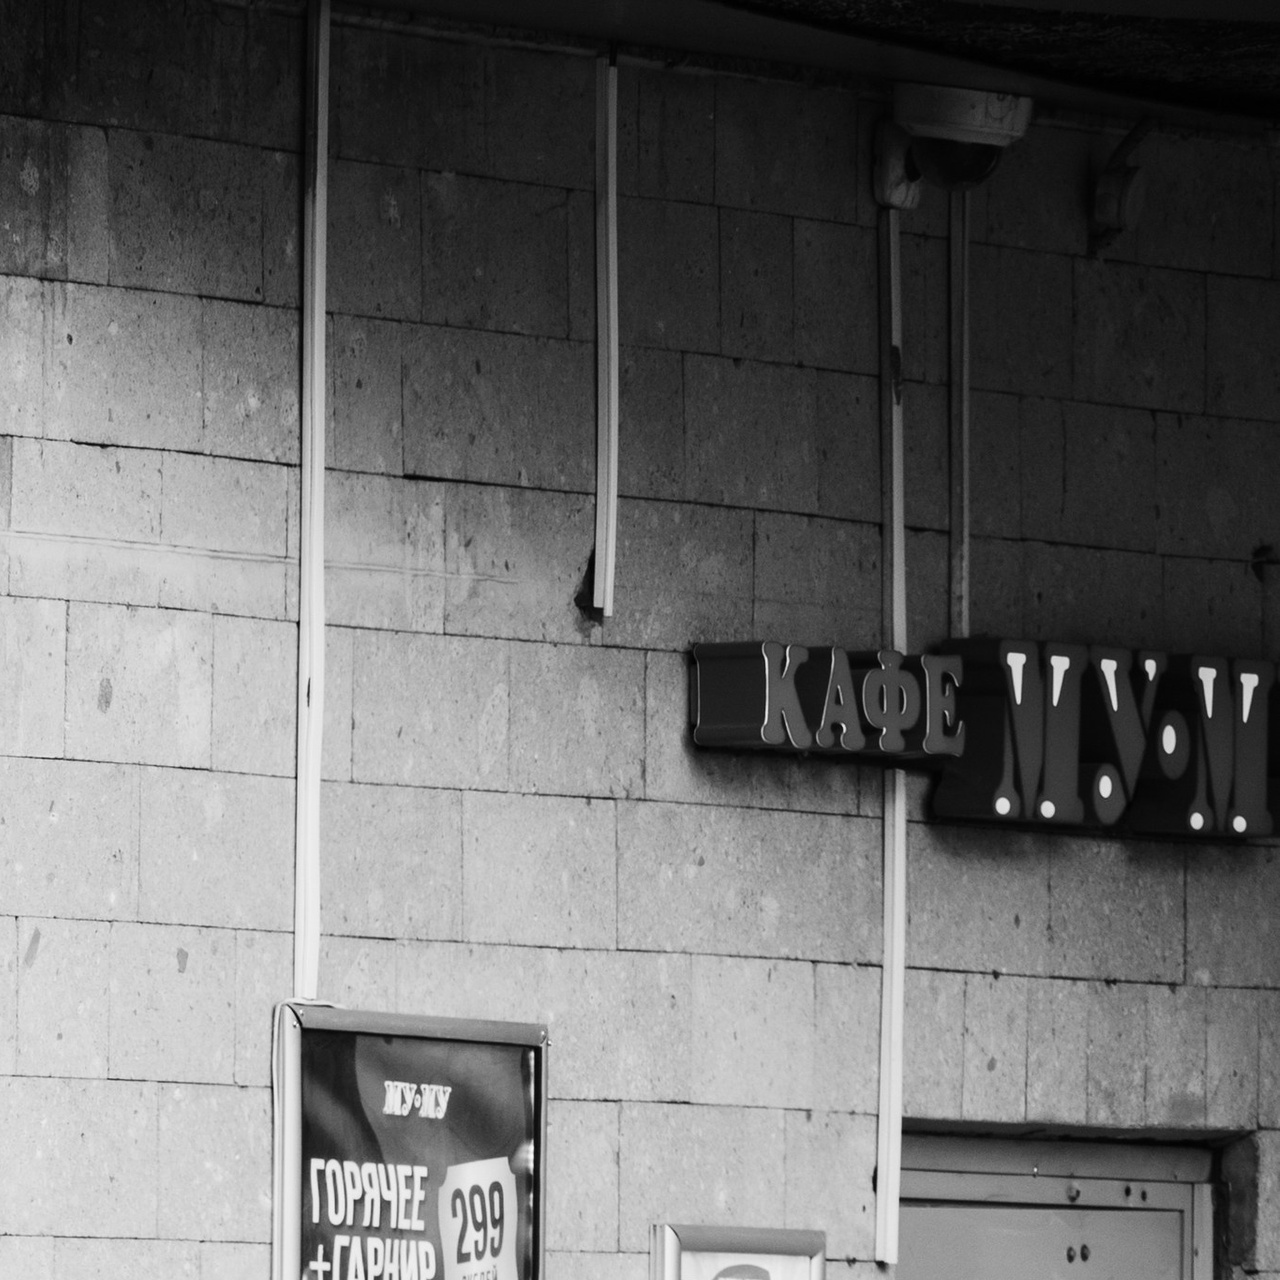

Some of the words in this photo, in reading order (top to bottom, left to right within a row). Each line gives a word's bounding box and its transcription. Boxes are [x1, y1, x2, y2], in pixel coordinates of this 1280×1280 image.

[760, 640, 966, 757] КАФЕ
[310, 1157, 428, 1231] ГОРЯЧЕЕ
[450, 1180, 505, 1265] 299
